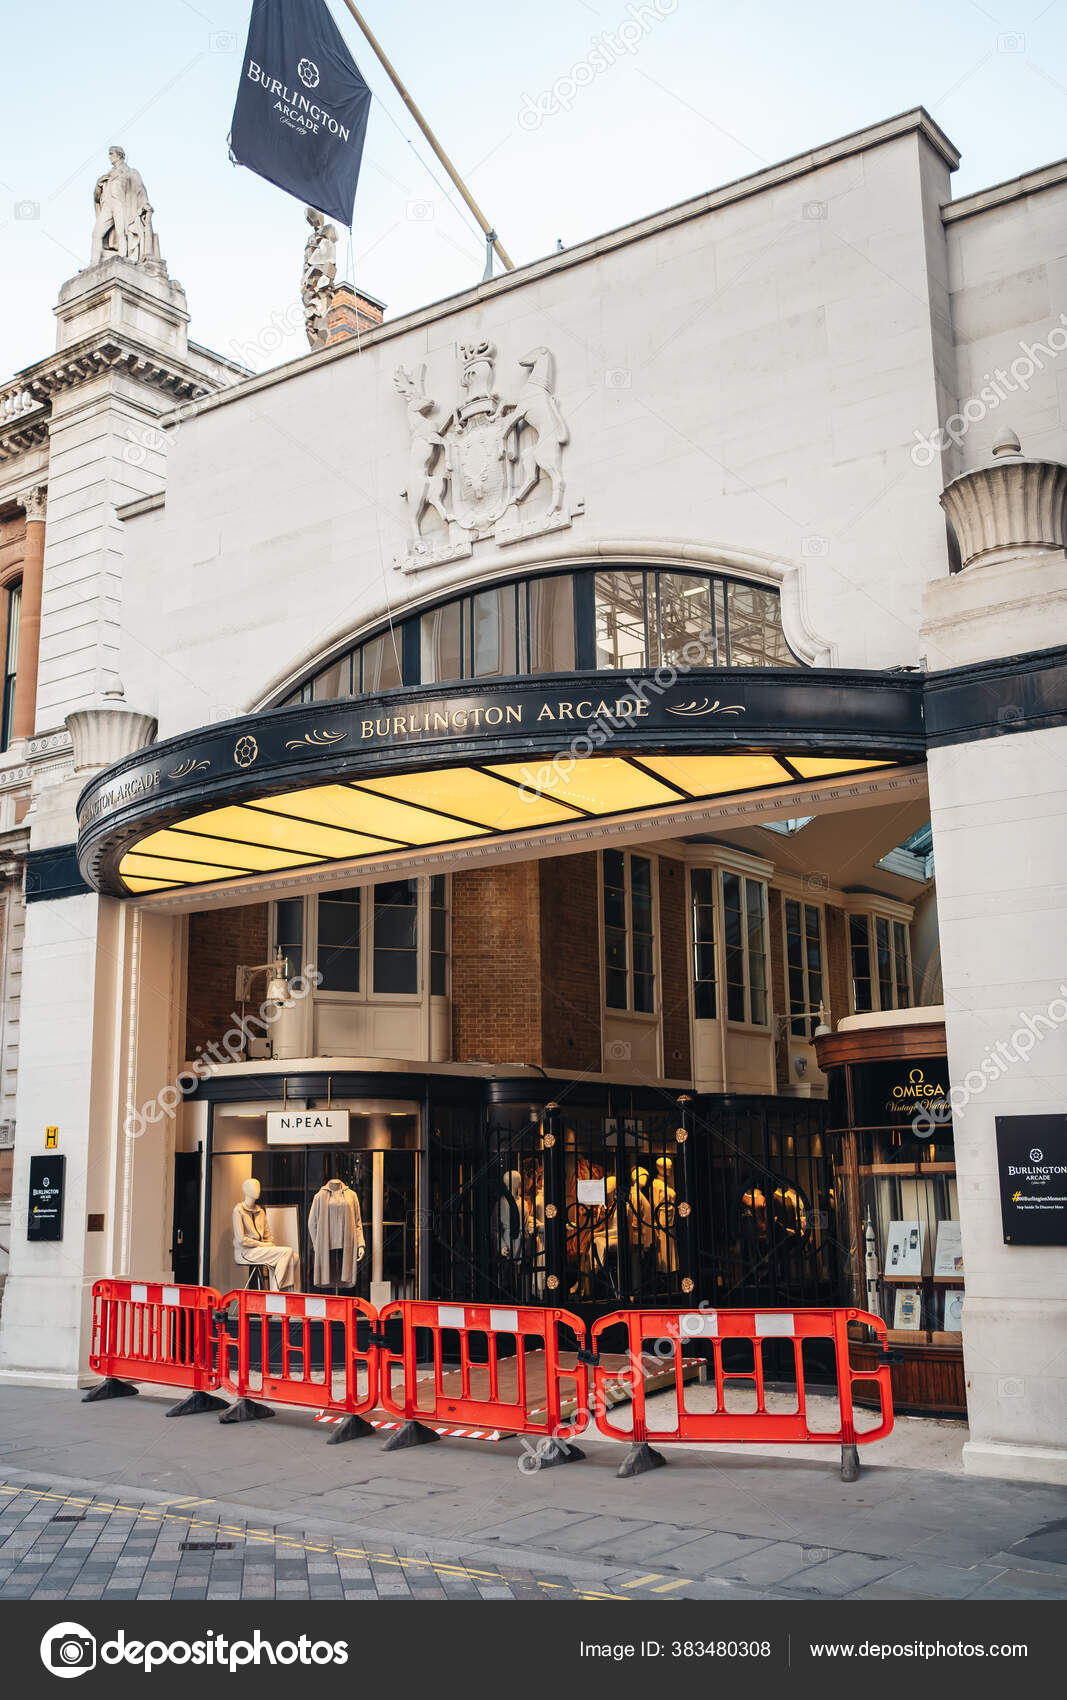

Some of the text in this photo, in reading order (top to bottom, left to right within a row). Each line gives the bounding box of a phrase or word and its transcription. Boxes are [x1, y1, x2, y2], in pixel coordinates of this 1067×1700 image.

[247, 60, 350, 142] BURLINGTON
[273, 101, 320, 135] ARCADE
[360, 700, 649, 740] BURLINGTON ARCADE
[117, 769, 161, 802] ARCADE
[892, 1084, 945, 1098] OMEGA
[280, 1116, 333, 1129] N.PEAL
[46, 1128, 57, 1146] H
[1008, 1165, 1067, 1175] BURLINGTON
